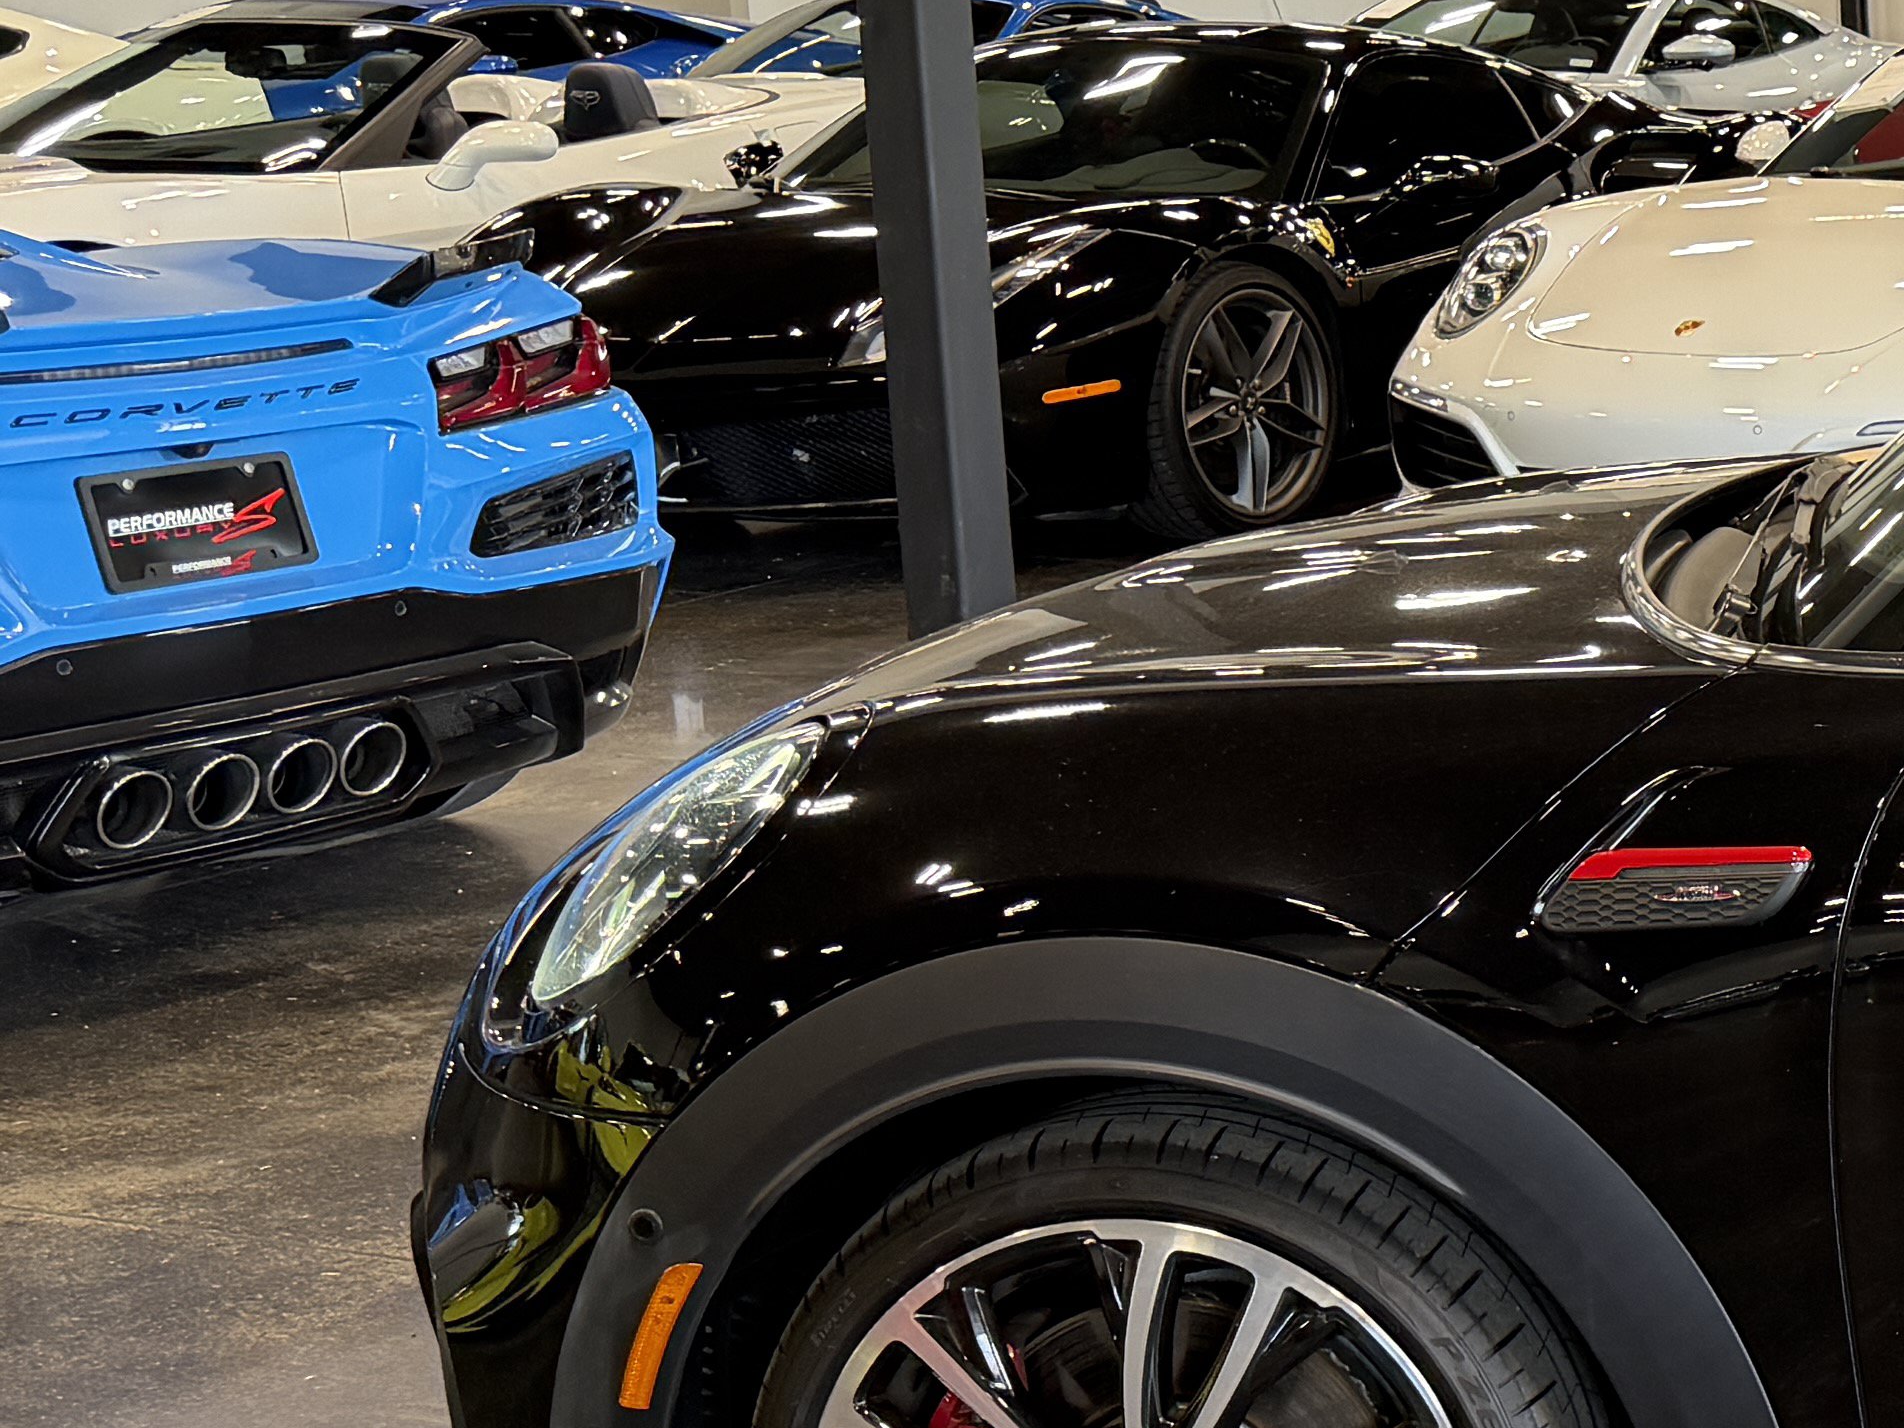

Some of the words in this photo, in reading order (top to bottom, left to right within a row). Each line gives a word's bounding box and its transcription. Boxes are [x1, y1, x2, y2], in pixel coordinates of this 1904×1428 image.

[9, 378, 361, 429] CORVETTE
[107, 501, 235, 537] PERFORMANCE
[109, 521, 236, 548] LUXURY
